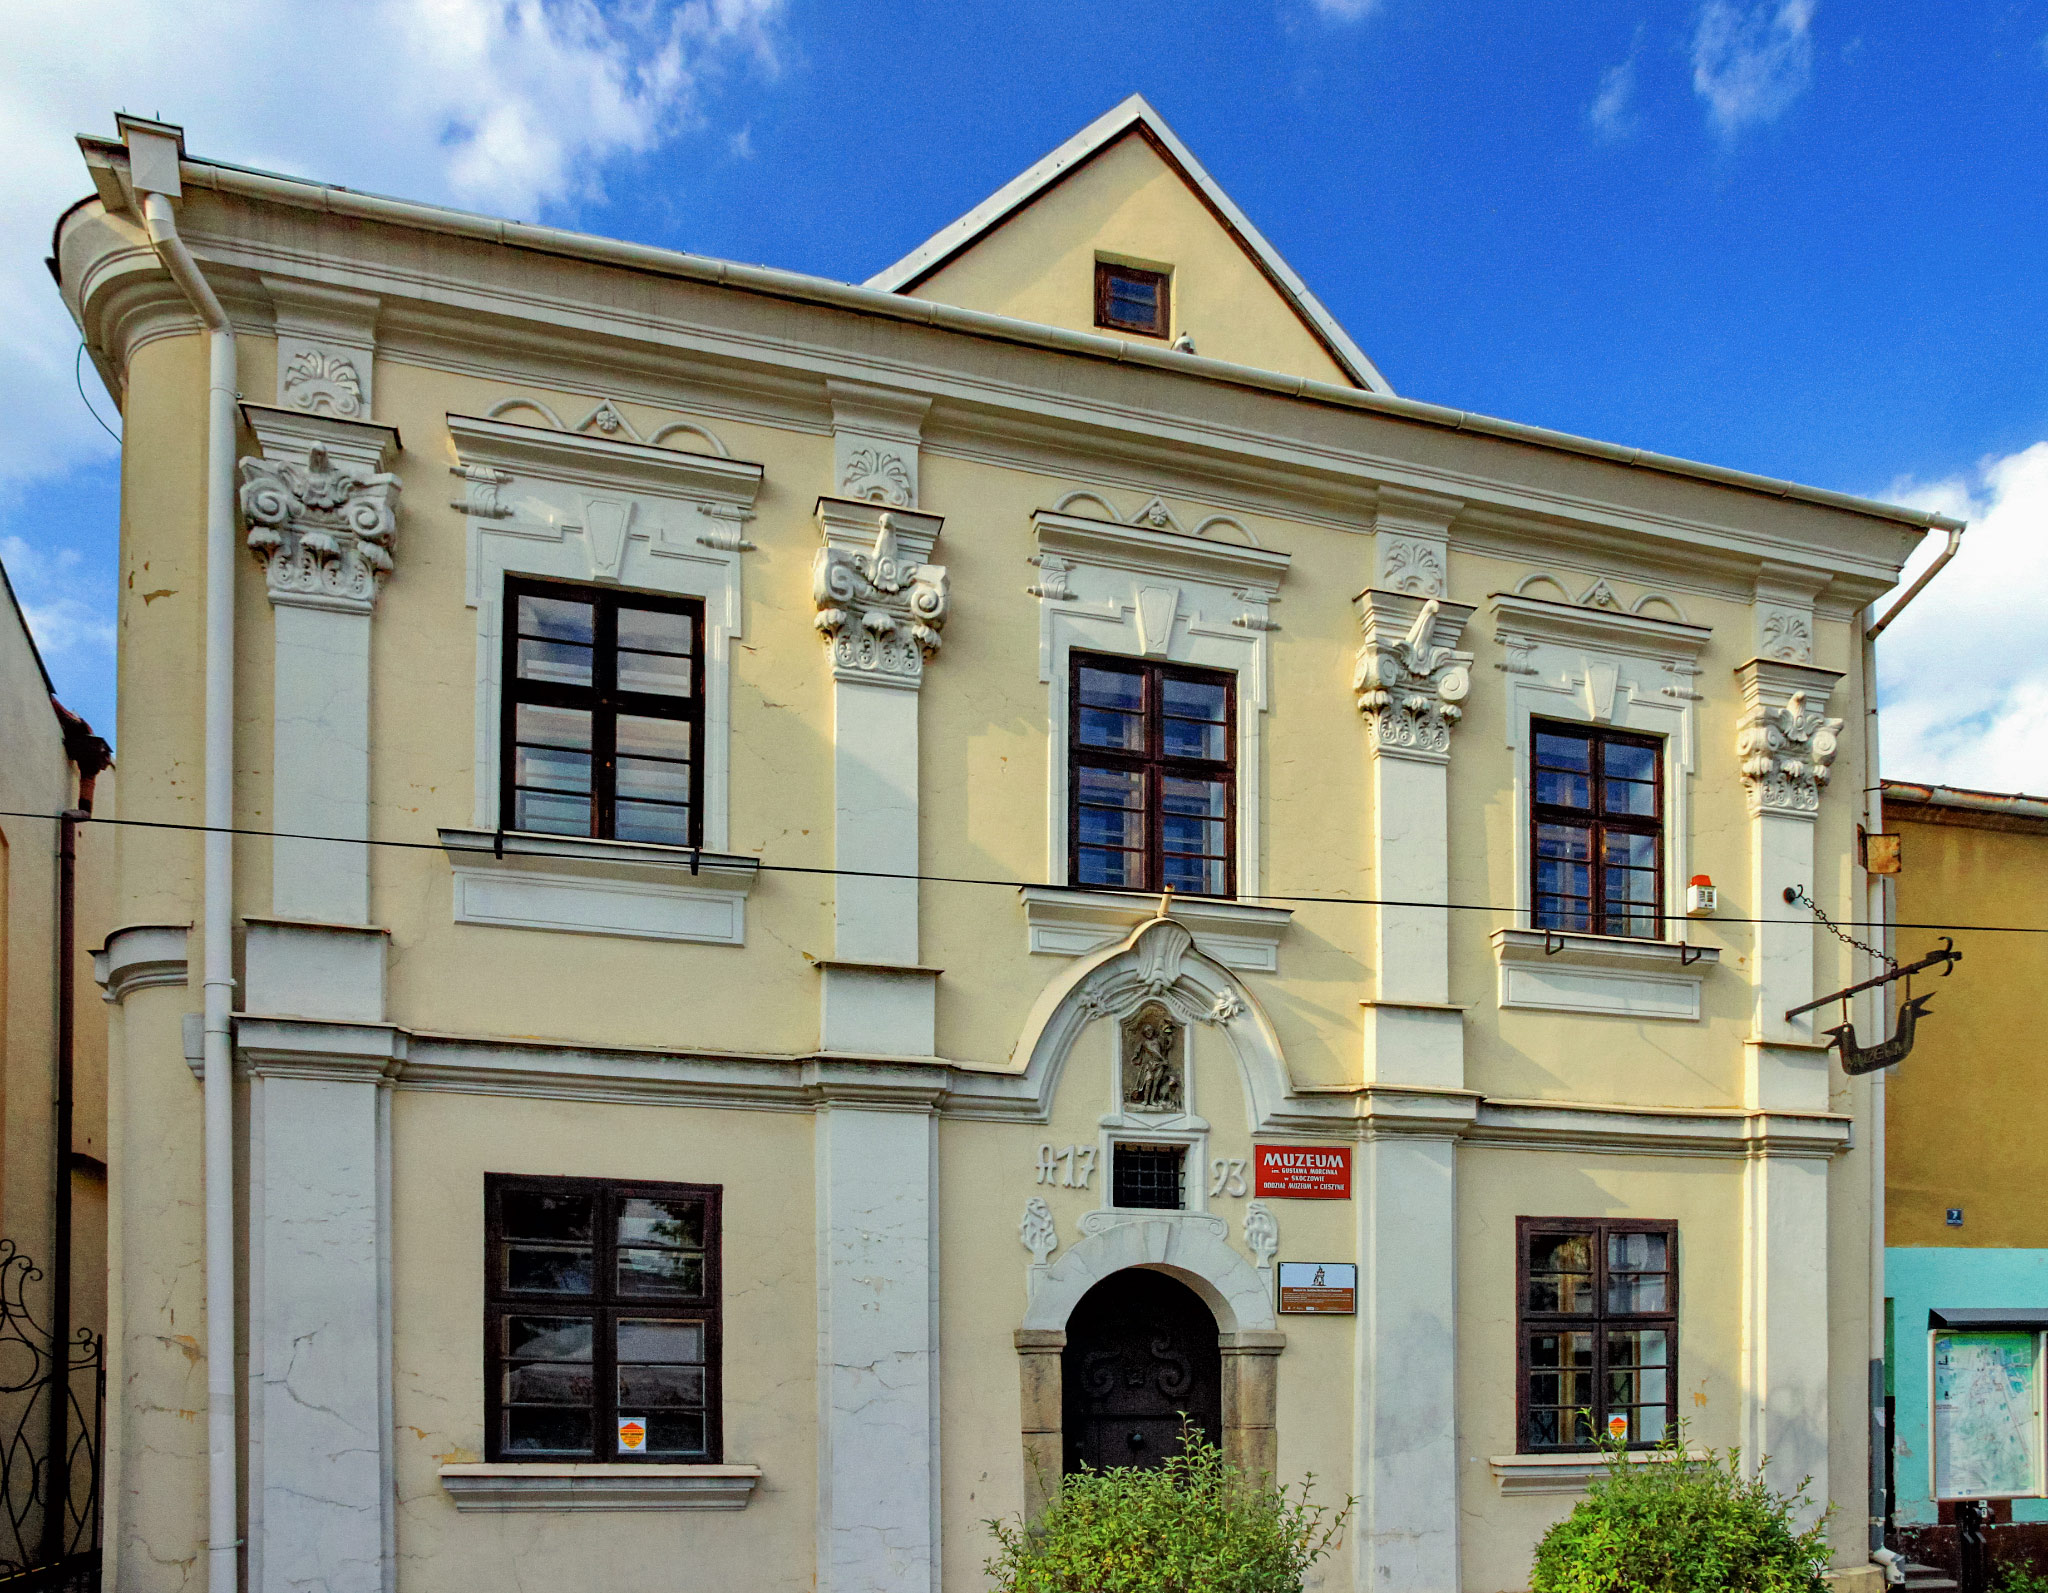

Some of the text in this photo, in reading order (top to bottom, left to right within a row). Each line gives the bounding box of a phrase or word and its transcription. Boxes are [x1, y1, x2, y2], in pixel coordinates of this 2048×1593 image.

[1263, 1152, 1344, 1168] MUZEUM
[1288, 1182, 1312, 1190] MUZEUM
[1319, 1183, 1345, 1191] CIESZYNIE
